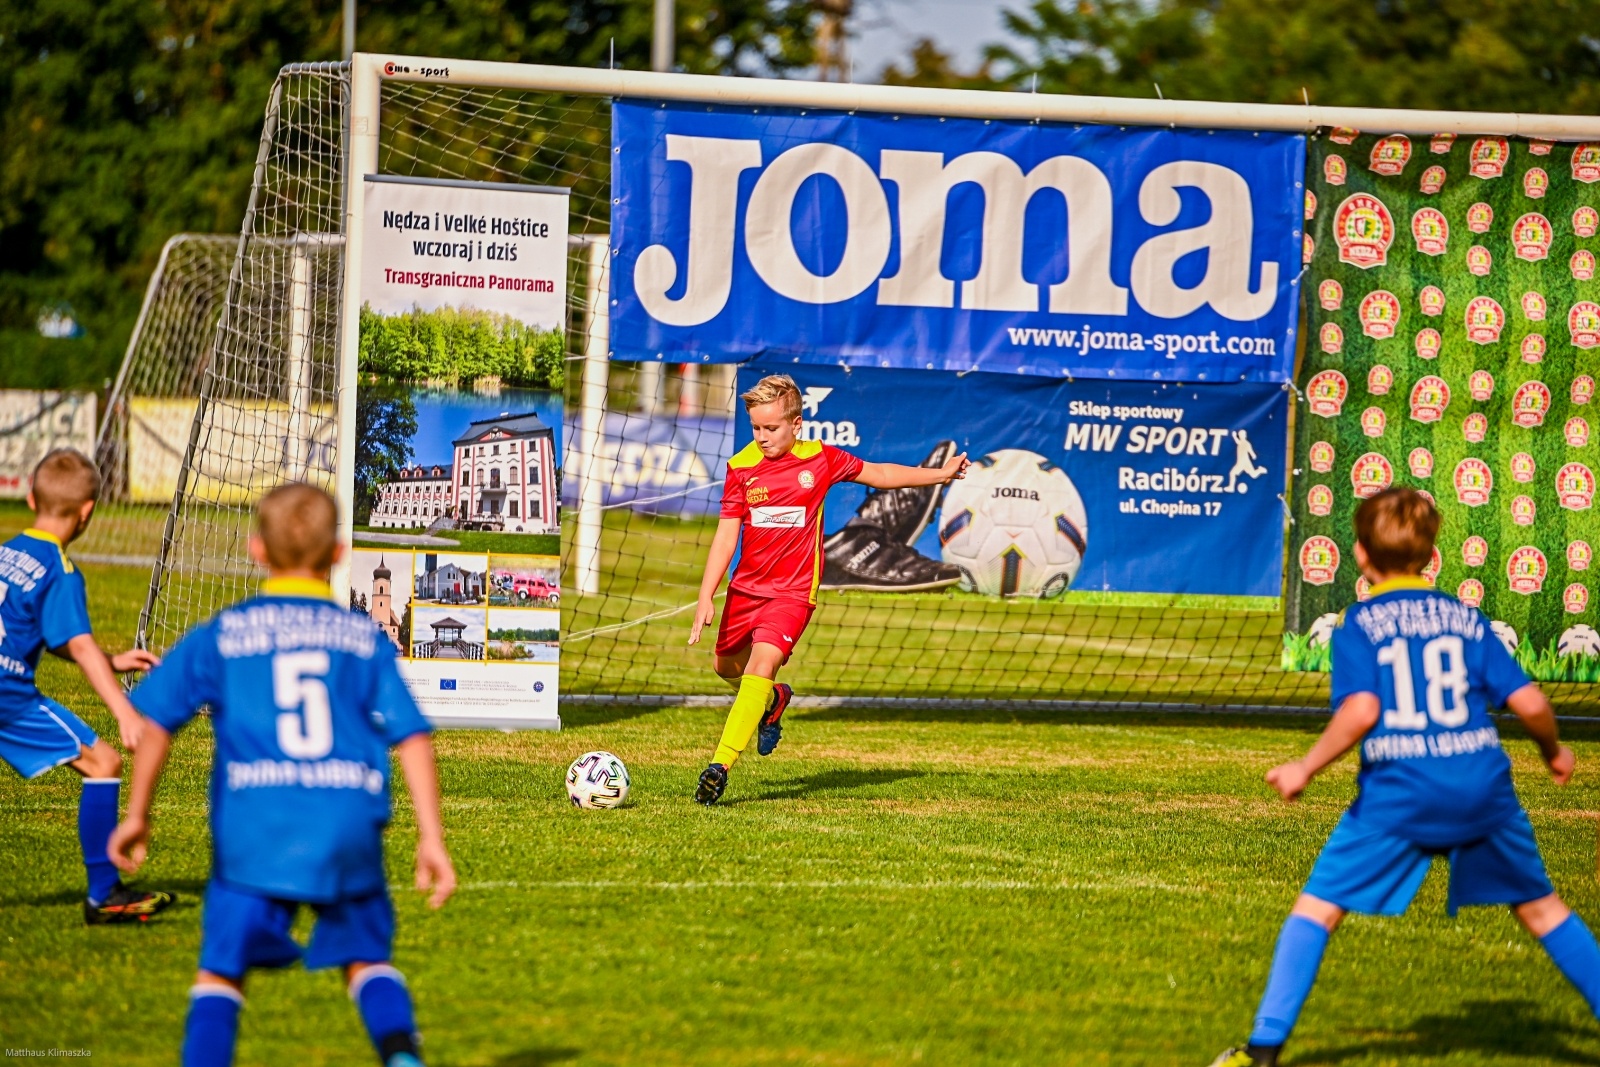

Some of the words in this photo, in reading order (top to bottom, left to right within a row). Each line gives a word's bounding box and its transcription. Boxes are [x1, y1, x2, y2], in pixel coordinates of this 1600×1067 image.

[420, 67, 450, 78] sport
[383, 210, 430, 233] Nędza
[434, 212, 440, 231] i
[443, 214, 487, 234] Velké
[491, 217, 549, 238] Hoštice
[413, 240, 473, 262] wczoraj
[477, 240, 483, 260] i
[487, 242, 518, 261] dziś
[384, 268, 485, 288] Transgraniczna
[488, 275, 554, 293] Panorama
[1007, 324, 1276, 359] www.joma-sport.com
[1069, 400, 1112, 420] Sklep
[1113, 404, 1184, 423] sportowy
[1064, 423, 1122, 452] MW
[1126, 425, 1228, 456] SPORT
[746, 486, 769, 497] GMINA
[1119, 466, 1224, 493] Racibórz
[1119, 498, 1140, 514] ul.
[1141, 499, 1201, 518] Chopina
[1203, 502, 1222, 516] 17
[1377, 634, 1470, 731] 18
[272, 650, 334, 760] 5
